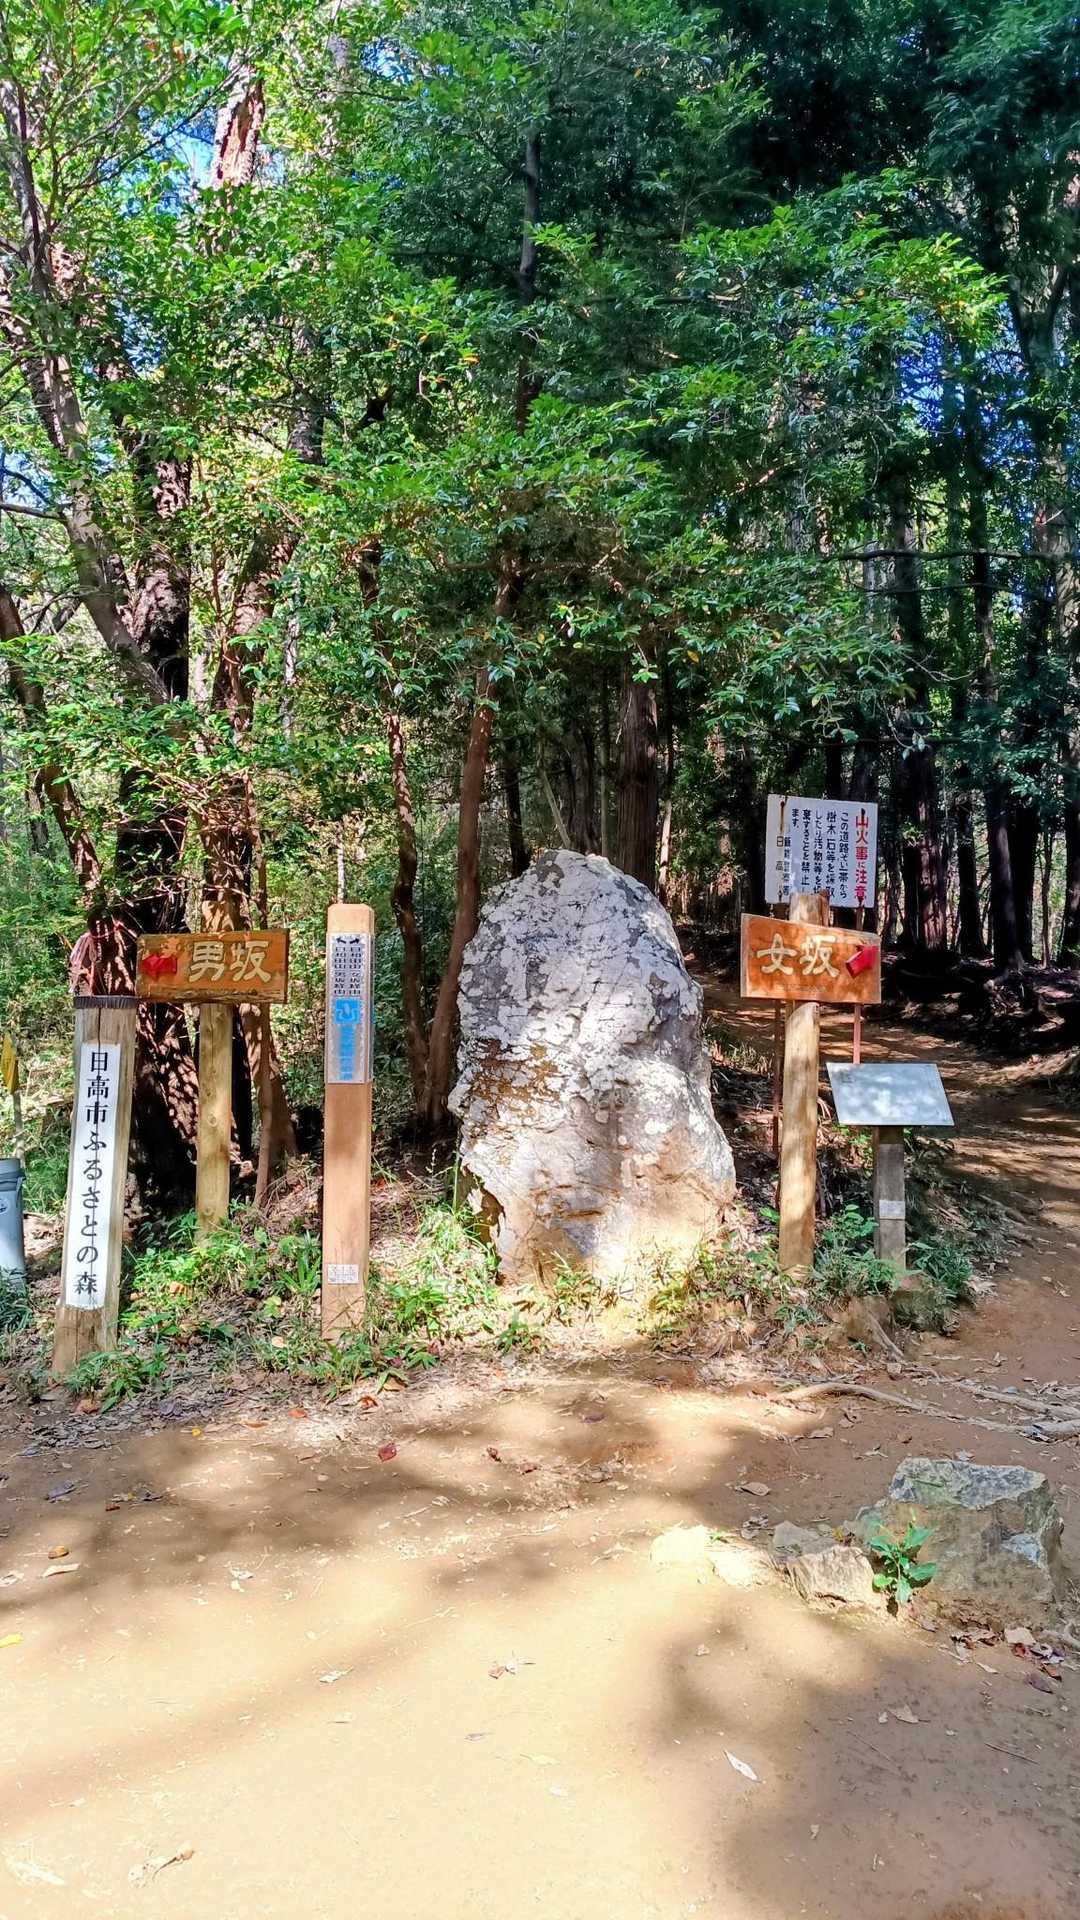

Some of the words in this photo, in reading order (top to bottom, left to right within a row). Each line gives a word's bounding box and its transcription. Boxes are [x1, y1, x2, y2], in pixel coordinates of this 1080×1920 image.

[854, 815, 869, 899] 山火事に注意
[188, 940, 272, 983] 男坂
[756, 932, 840, 978] 女坂
[74, 1051, 109, 1295] 日高市ふるさとの森
